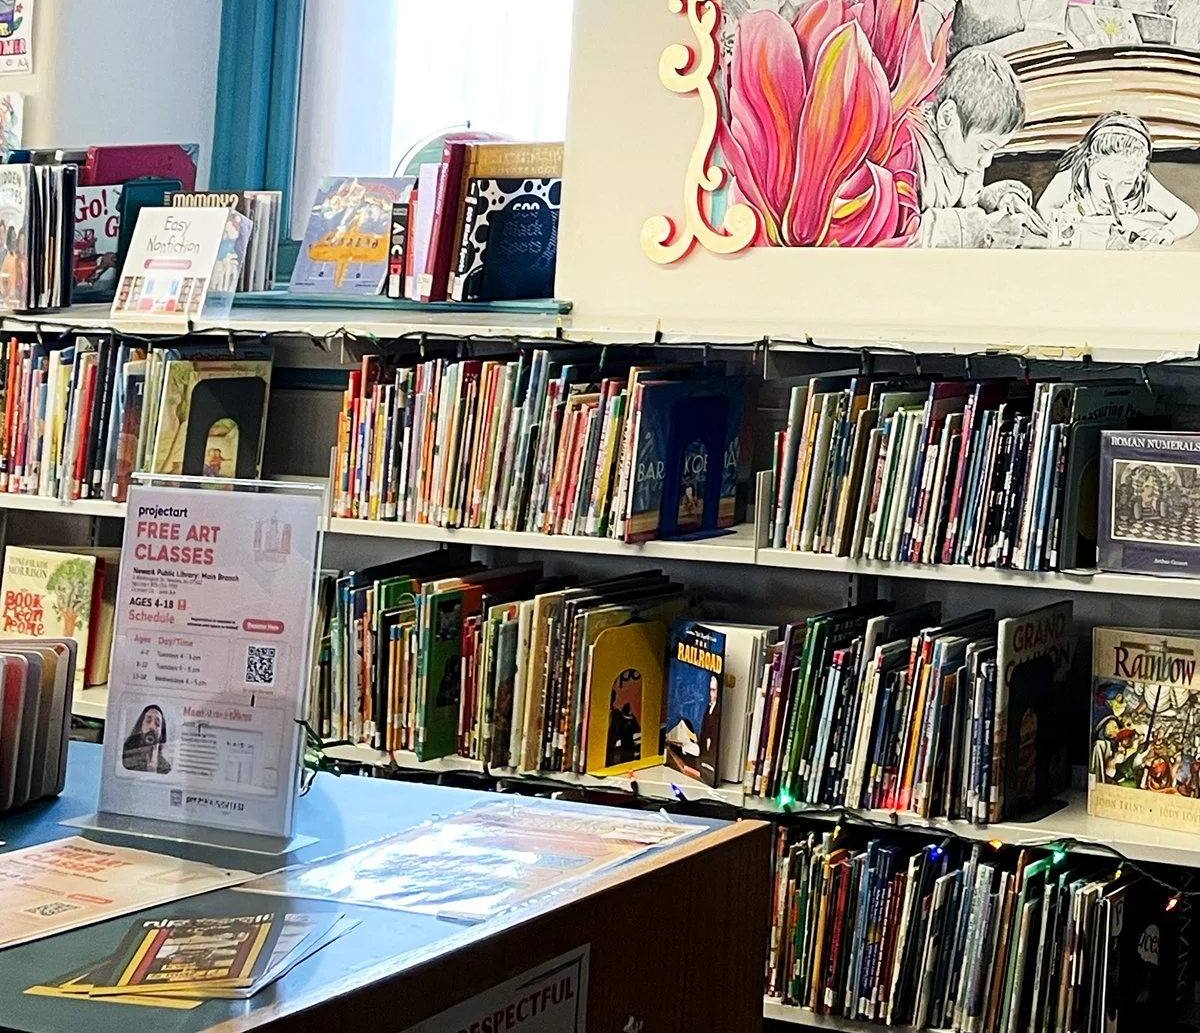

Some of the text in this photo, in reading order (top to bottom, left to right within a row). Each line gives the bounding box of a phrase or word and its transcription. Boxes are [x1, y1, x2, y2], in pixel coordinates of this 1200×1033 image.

[164, 215, 192, 237] Easy
[146, 234, 201, 255] Nonfiction
[1111, 436, 1145, 448] ROMAN
[1147, 439, 1200, 452] NUMERALS
[138, 505, 188, 518] projectart
[137, 521, 221, 543] FREE ART
[135, 543, 214, 566] CLASSES
[157, 568, 175, 577] Public
[201, 572, 217, 580] Main
[129, 597, 174, 609] AGES 4-18
[128, 609, 175, 624] Schedule
[678, 642, 722, 674] RAILROAD
[1113, 642, 1196, 686] Rainbow
